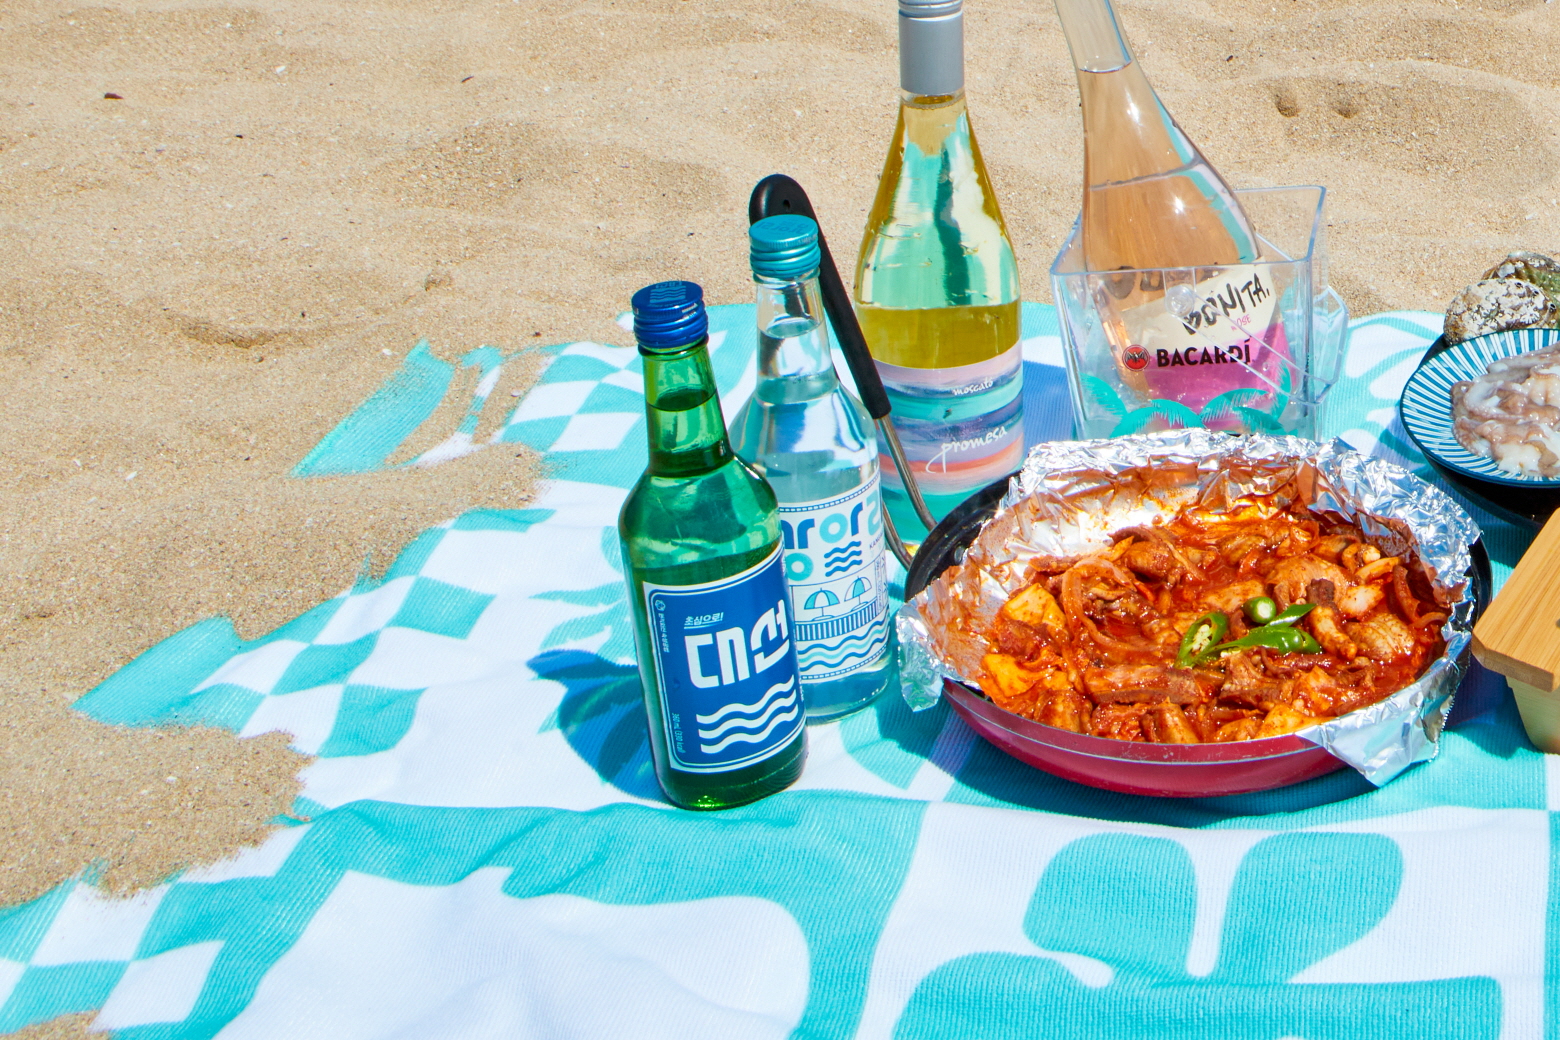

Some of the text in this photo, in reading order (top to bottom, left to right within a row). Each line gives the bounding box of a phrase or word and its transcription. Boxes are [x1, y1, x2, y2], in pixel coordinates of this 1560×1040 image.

[925, 425, 1008, 474] promesa
[683, 611, 724, 627] 초심으로!
[684, 599, 790, 689] 대선
